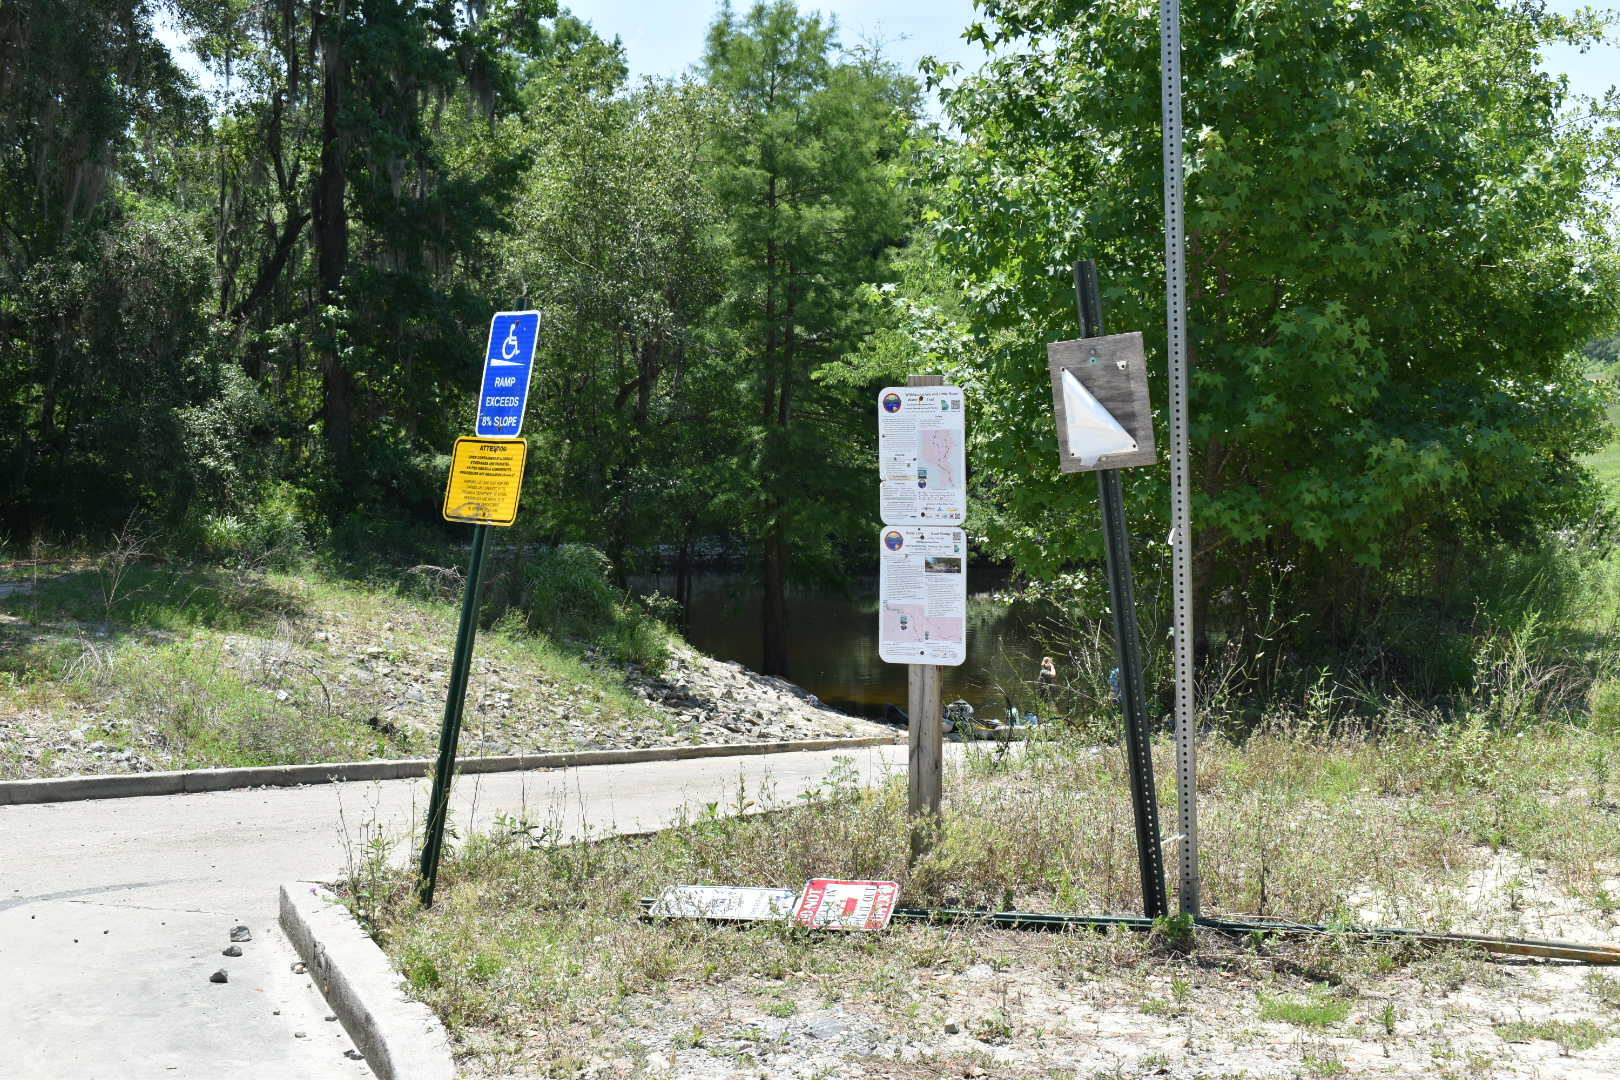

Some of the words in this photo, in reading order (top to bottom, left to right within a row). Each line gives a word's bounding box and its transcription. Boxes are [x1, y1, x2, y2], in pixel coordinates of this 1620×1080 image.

[494, 377, 515, 387] RAMP
[485, 396, 519, 407] EXCEEDS
[481, 416, 491, 426] 8%
[494, 416, 517, 427] SLOPE
